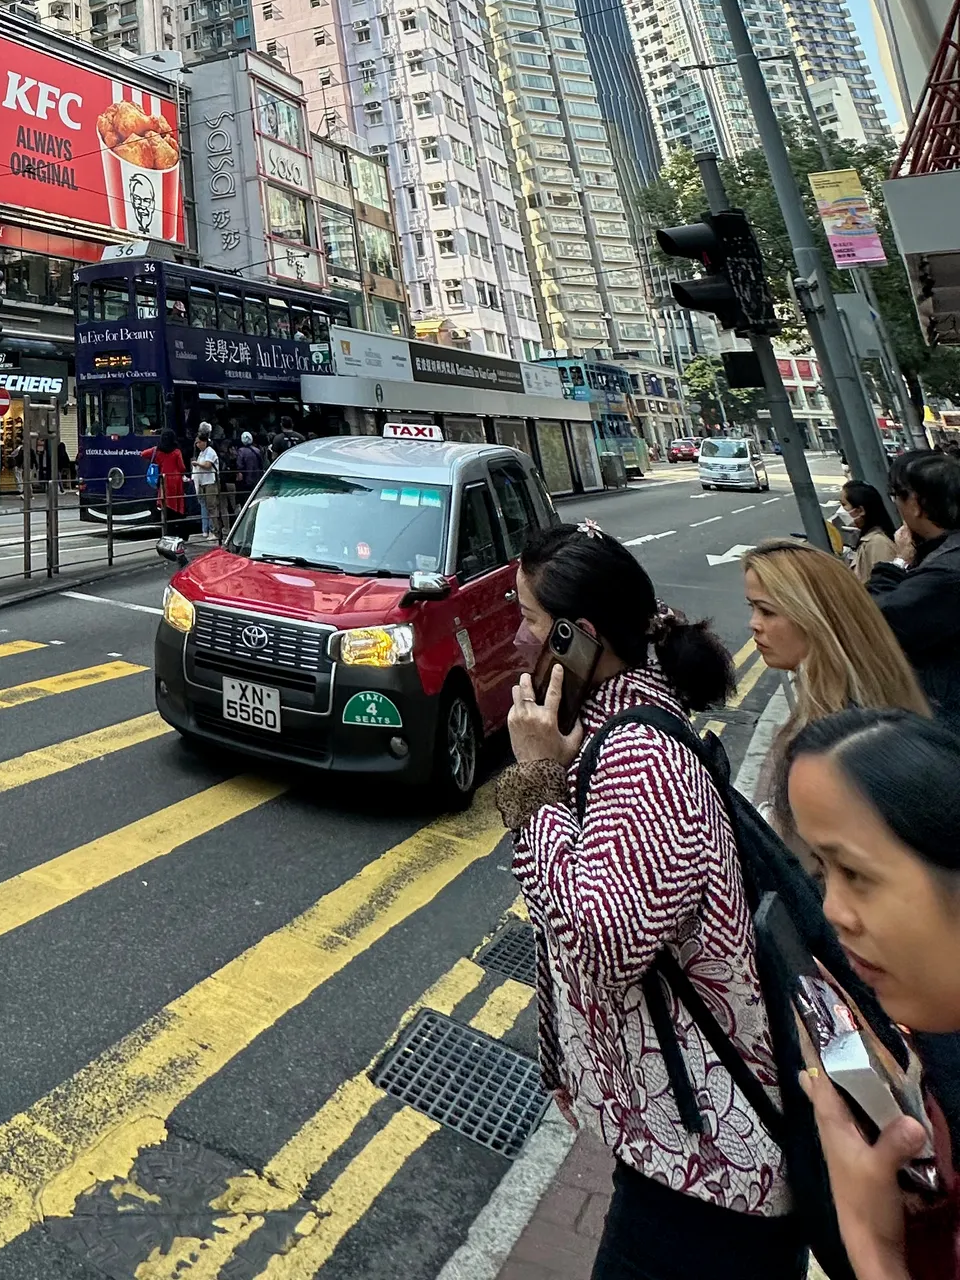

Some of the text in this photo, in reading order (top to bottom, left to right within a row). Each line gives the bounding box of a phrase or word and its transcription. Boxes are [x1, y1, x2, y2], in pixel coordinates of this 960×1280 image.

[2, 70, 83, 130] KFC
[16, 125, 73, 161] ALWAYS
[10, 152, 78, 191] ORIGINAL
[115, 244, 134, 257] 36
[144, 264, 155, 272] 36
[73, 273, 79, 281] 36
[105, 329, 118, 341] for
[120, 328, 155, 341] Beauty
[256, 343, 271, 367] An
[272, 345, 294, 373] Eye
[295, 347, 310, 371] for
[388, 425, 435, 438] TAXI
[238, 683, 264, 706] XN
[359, 693, 383, 703] TAXI
[226, 700, 277, 729] 5560
[366, 702, 378, 716] 4
[355, 715, 391, 724] SEATS
